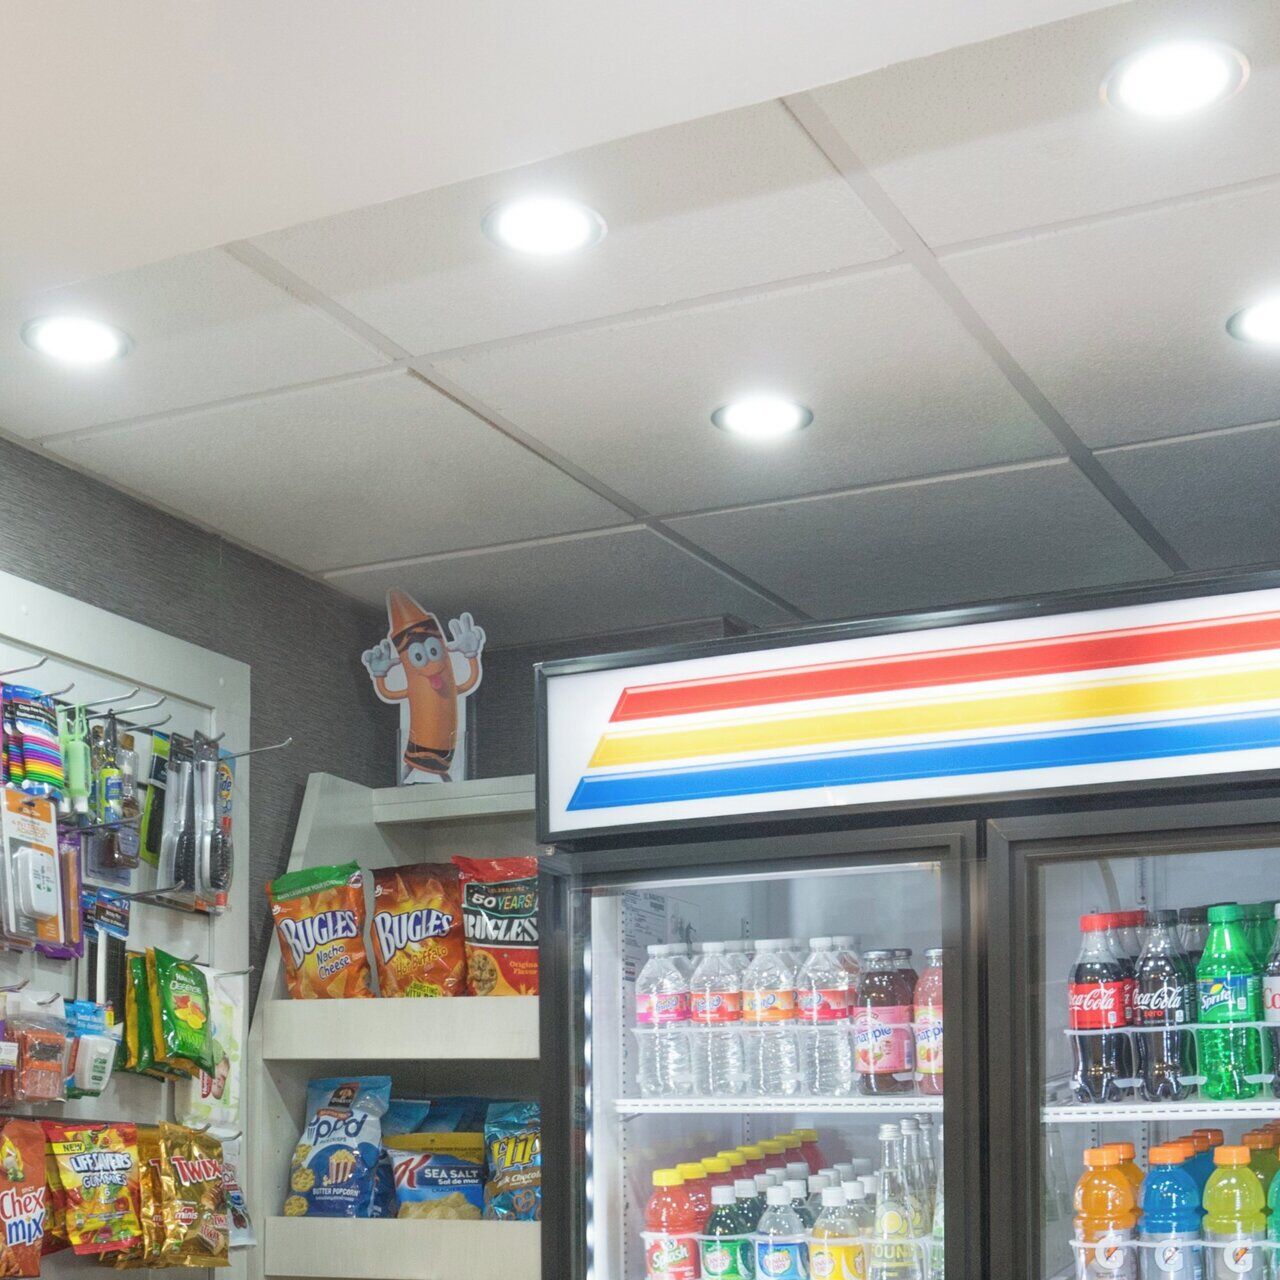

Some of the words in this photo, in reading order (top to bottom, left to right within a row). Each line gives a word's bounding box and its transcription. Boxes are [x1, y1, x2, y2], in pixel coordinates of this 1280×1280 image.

[279, 911, 358, 967] BUGLES
[373, 909, 454, 965] BUGLES
[316, 945, 345, 963] Nacho
[319, 955, 351, 979] Cheese
[169, 981, 203, 993] DEFENSE
[62, 1143, 82, 1152] NEW
[83, 1173, 128, 1187] GUMMIES
[424, 1168, 450, 1179] SEA
[453, 1168, 478, 1178] SALT
[7, 1213, 43, 1248] mix
